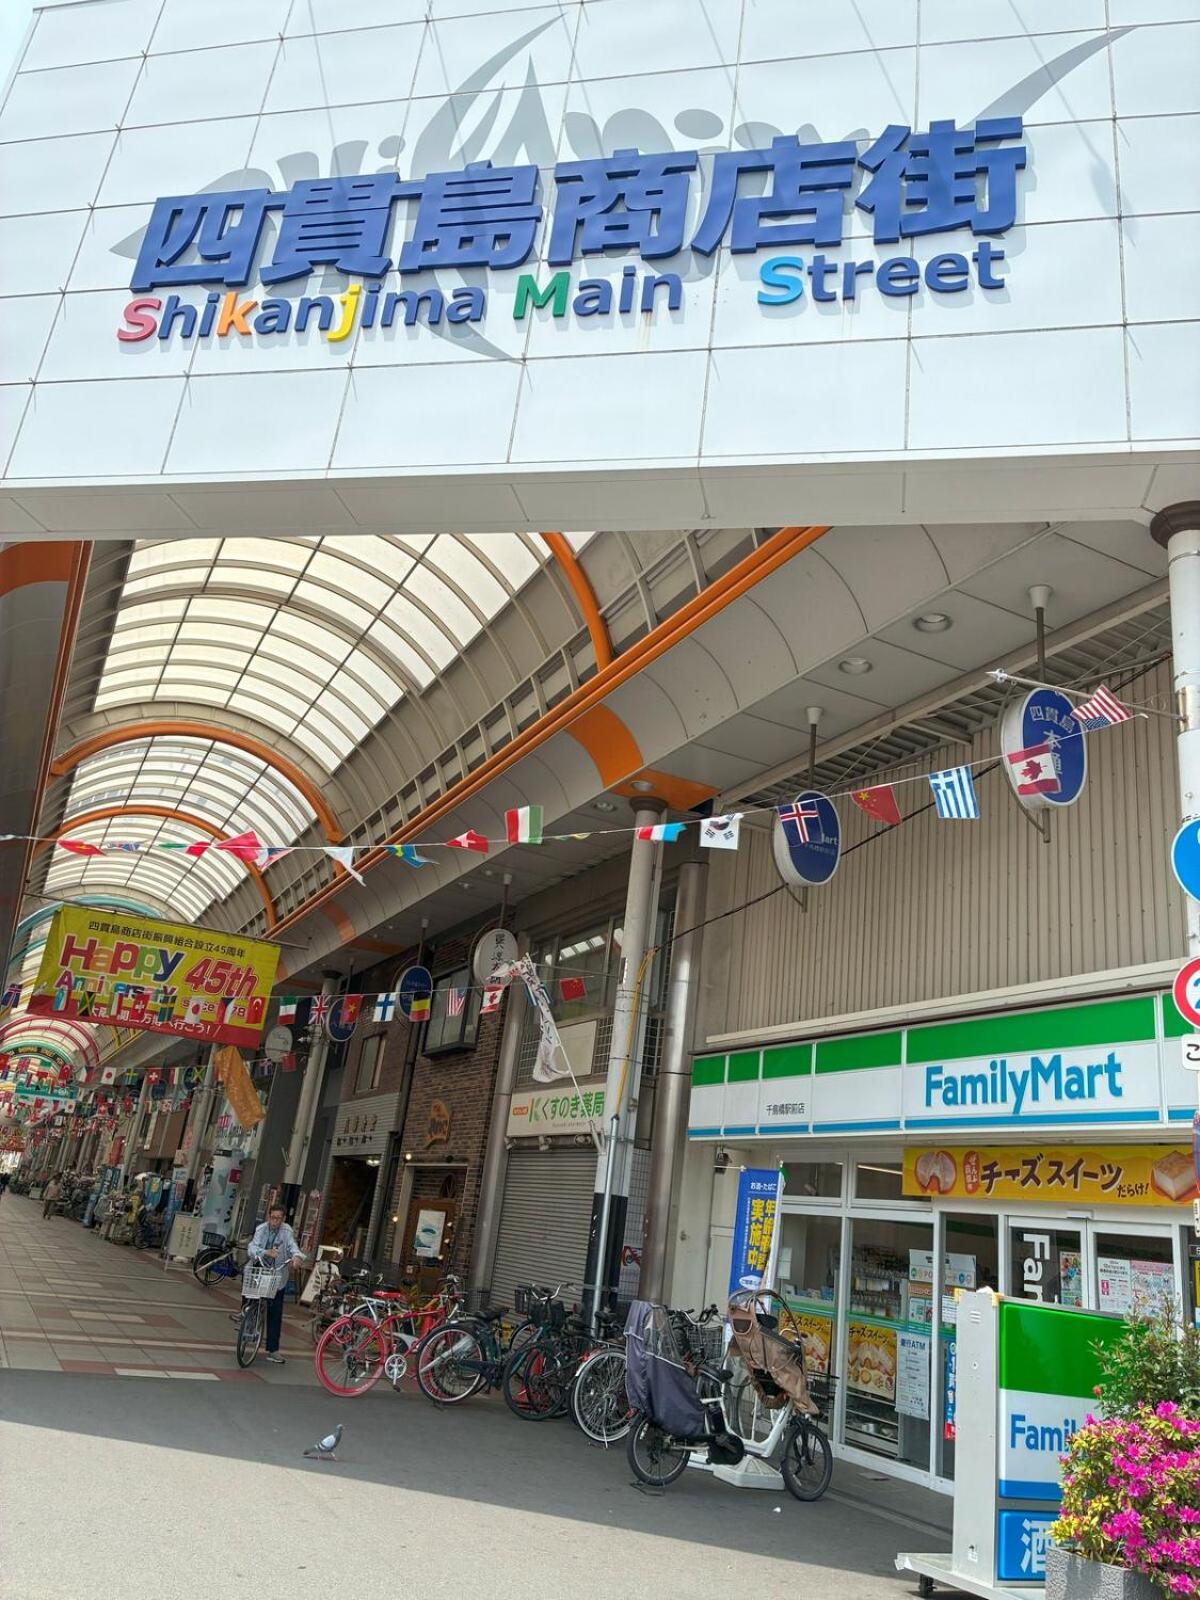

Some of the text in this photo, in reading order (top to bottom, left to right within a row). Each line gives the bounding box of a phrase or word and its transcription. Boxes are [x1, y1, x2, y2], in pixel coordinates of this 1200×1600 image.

[130, 116, 1027, 293] 四貫島商店街
[117, 242, 1005, 342] Shikanjima Main Street
[59, 934, 259, 996] Happy 45th
[925, 1052, 1124, 1114] FamilyMart
[980, 1153, 1123, 1194] チーズスイーツ
